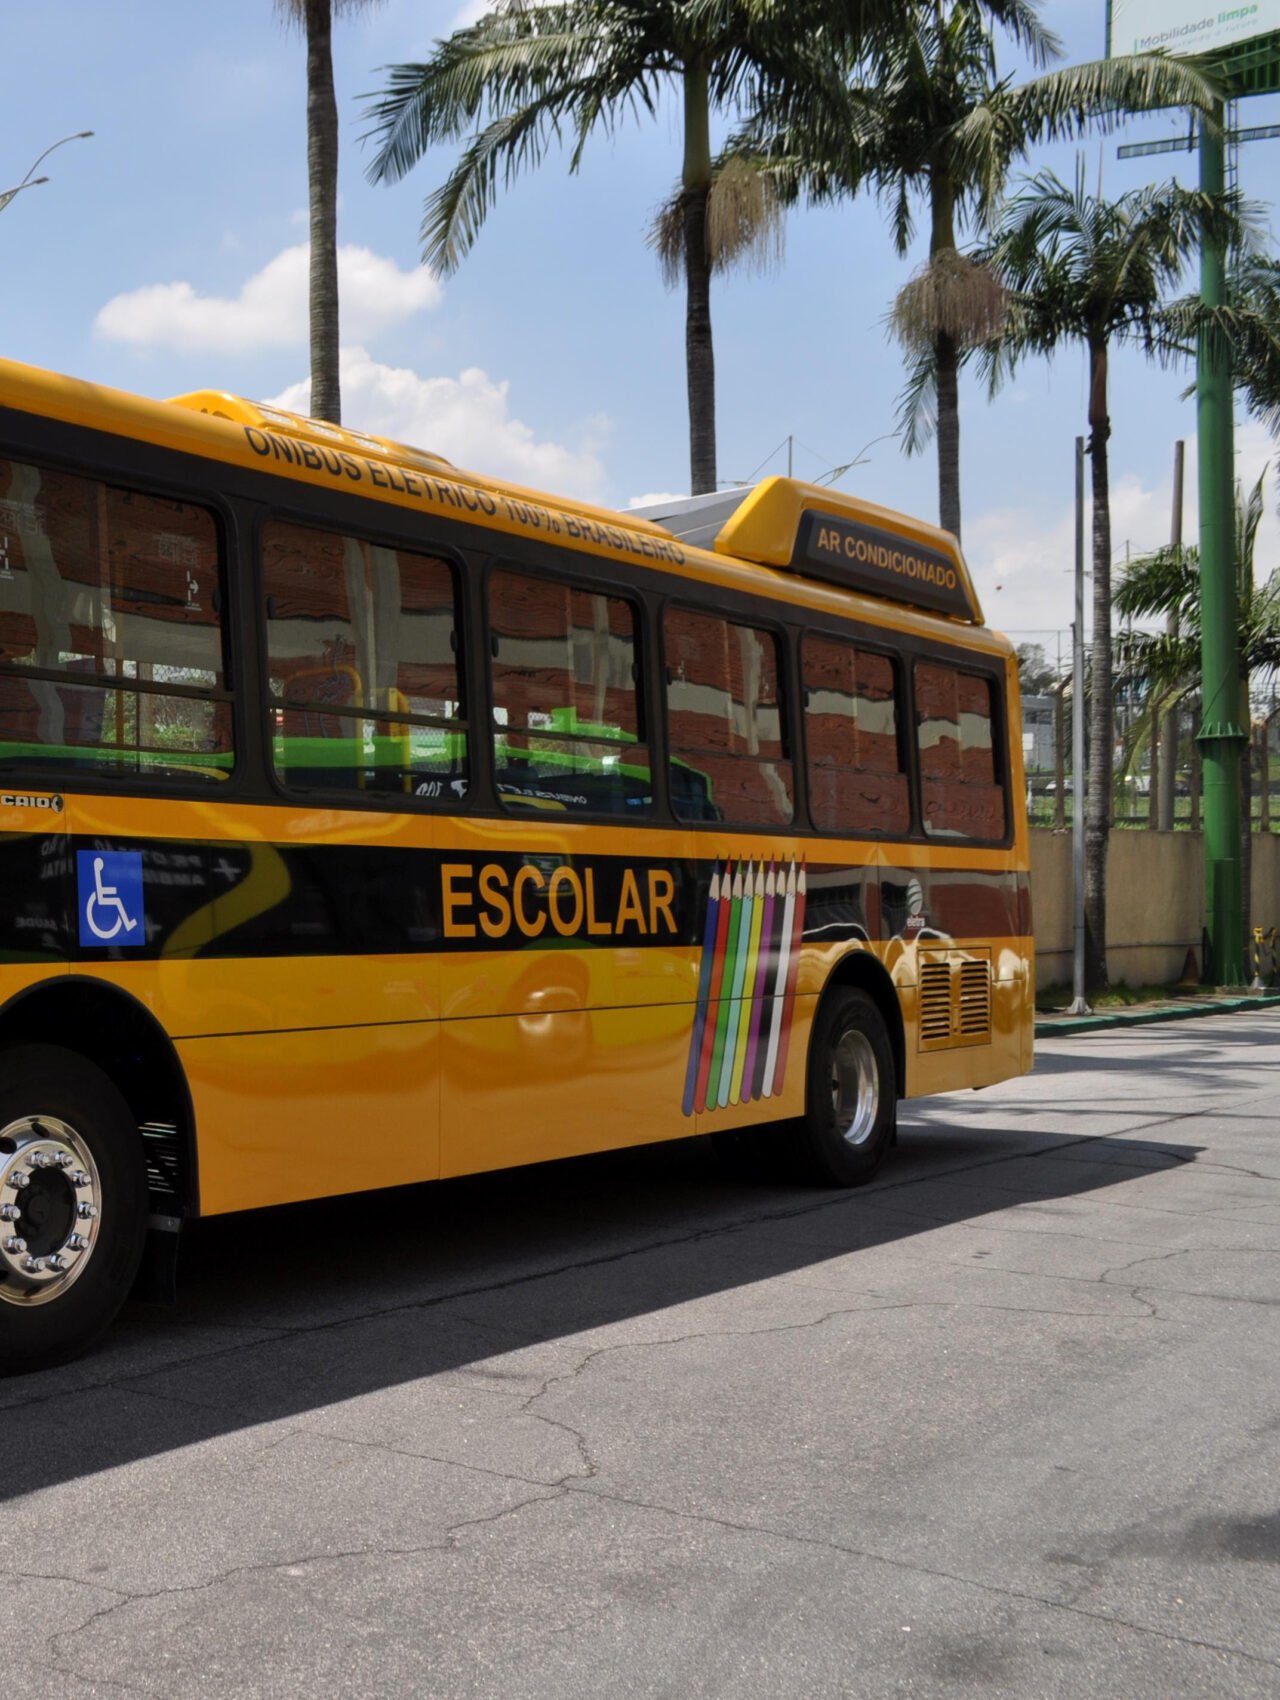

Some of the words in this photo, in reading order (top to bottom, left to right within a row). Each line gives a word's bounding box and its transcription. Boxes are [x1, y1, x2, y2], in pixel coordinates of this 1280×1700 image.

[1140, 16, 1215, 48] Mobilidade
[1218, 3, 1259, 25] limpa
[499, 496, 561, 534] 100%
[561, 513, 686, 566] BRASILEIRO
[817, 527, 841, 554] AR
[844, 536, 957, 589] CONDICIONADO
[0, 794, 50, 809] CAIO
[440, 863, 678, 938] ESCOLAR
